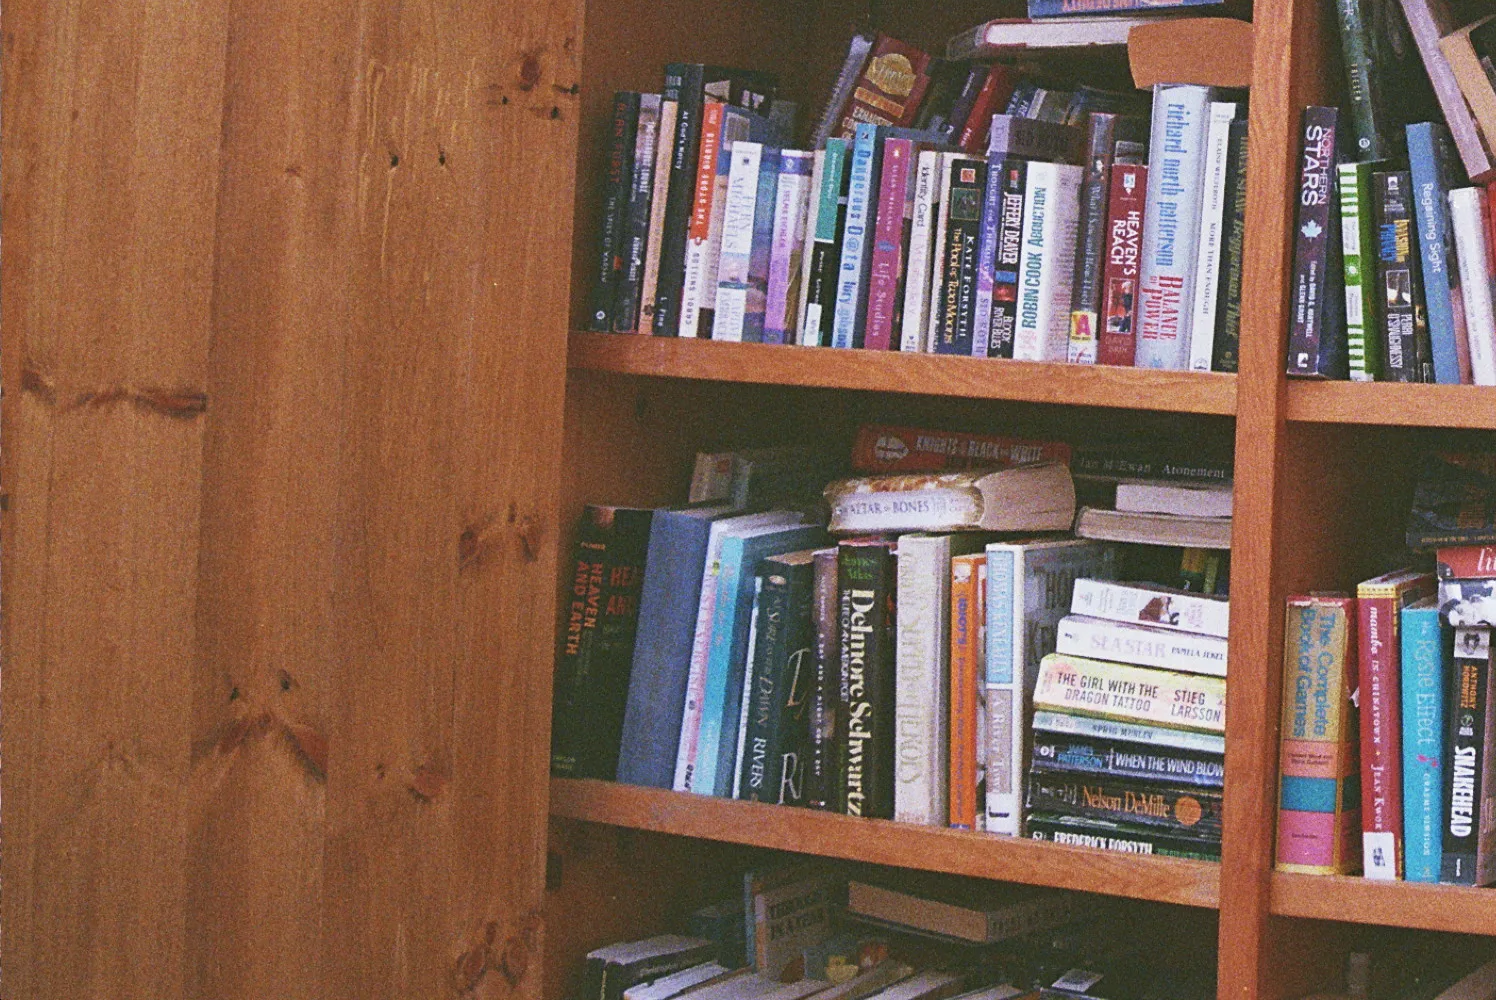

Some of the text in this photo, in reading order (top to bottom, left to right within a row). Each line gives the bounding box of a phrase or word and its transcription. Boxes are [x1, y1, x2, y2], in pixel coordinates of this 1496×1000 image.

[673, 110, 689, 170] At God's Mercy
[694, 208, 706, 226] THE
[702, 132, 715, 171] DIARIES
[915, 165, 930, 200] Identity
[988, 163, 1001, 207] THOUGHT
[1155, 103, 1191, 267] richard north patterson
[1301, 124, 1323, 206] STARS
[1318, 127, 1332, 205] NORTHERN
[726, 176, 756, 249] FERN MICHAELS
[843, 149, 872, 271] Dangerous D@ta
[916, 203, 929, 228] Card
[1003, 192, 1023, 229] JEFFERY
[1027, 186, 1047, 248] ABDUCTION
[1420, 183, 1442, 273] Regaining Sight
[948, 242, 962, 268] Pool
[952, 228, 962, 242] The
[1002, 230, 1021, 265] DEAVER
[1111, 219, 1126, 265] REACH
[1123, 211, 1140, 276] HEAVEN'S
[601, 251, 611, 283] WARSAW
[959, 235, 975, 337] KATE FORSYTH
[1202, 222, 1217, 315] MORE THAN ENOUGH
[685, 296, 697, 326] CAROL
[872, 262, 890, 337] Life Studies
[946, 280, 960, 303] Two
[1020, 252, 1043, 330] ROBIN COOK
[1141, 287, 1164, 340] POWER
[1158, 275, 1184, 341] BALANCE
[1297, 284, 1307, 323] GLENN GRANT
[1305, 283, 1317, 338] DAVID HARTWELL
[836, 309, 852, 349] gibson
[943, 303, 956, 345] Moons
[990, 306, 1005, 349] RIVER BLUES
[1002, 315, 1014, 343] BLOODY
[1225, 302, 1241, 340] Thief
[1402, 313, 1413, 336] PERRI
[1161, 463, 1225, 479] Atonement
[850, 501, 880, 516] ALTAR
[892, 499, 930, 514] BONES
[564, 560, 590, 656] AND EARTH
[583, 562, 604, 629] HEAVEN
[989, 554, 1011, 678] THOMAS KENEALLY
[849, 588, 876, 698] Delmore
[956, 597, 968, 646] IDIOT'S
[1317, 612, 1336, 646] The
[1368, 606, 1383, 655] mambo
[841, 640, 849, 678] AMERICAN
[1293, 607, 1317, 738] Book of Games
[1414, 639, 1437, 688] Rosie
[1057, 672, 1159, 699] THE GIRL WITH THE
[1064, 688, 1152, 713] DRAGON TATTOO
[1173, 688, 1206, 707] STIEG
[1311, 650, 1334, 737] Complete
[1460, 665, 1470, 710] HOROWITZ
[1468, 665, 1478, 710] ANTHONY
[1170, 703, 1221, 723] LARSSON
[1371, 676, 1382, 744] CHINATOWN
[1415, 692, 1437, 745] Effect
[991, 713, 1007, 753] River
[749, 737, 768, 789] RIVERS
[845, 701, 872, 817] Schwartz
[990, 758, 1006, 795] Town
[1056, 753, 1104, 769] PATTERSON
[1114, 750, 1195, 774] WHEN THE WIND
[1371, 764, 1384, 793] JEAN
[1082, 784, 1170, 818] Nelson DeMille
[1373, 797, 1386, 831] KWOK
[1449, 745, 1477, 838] SNAKEHEAD
[1053, 830, 1107, 851] FREDERICK
[1107, 836, 1154, 855] FORSYTH
